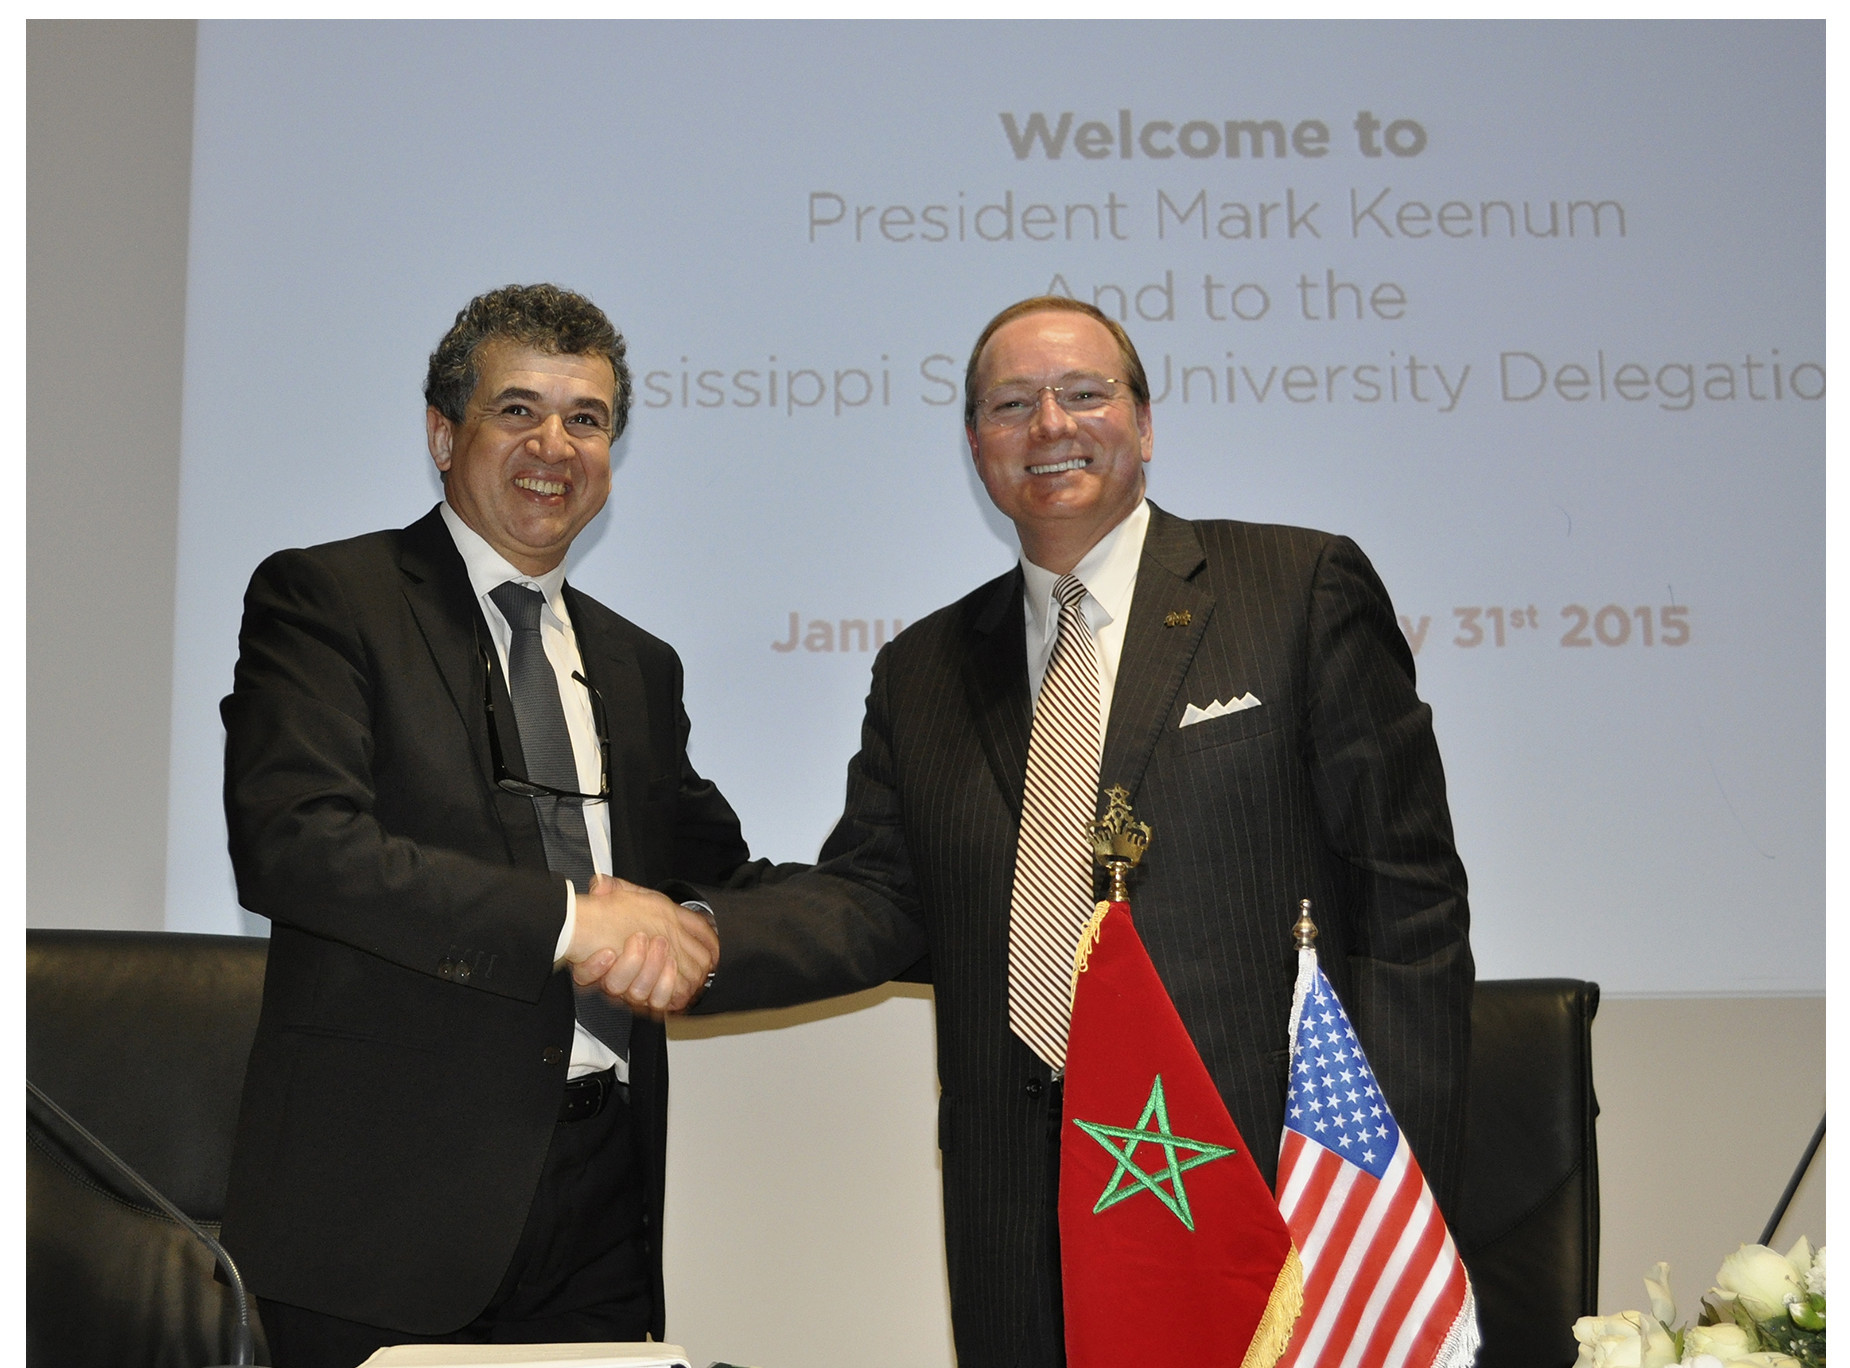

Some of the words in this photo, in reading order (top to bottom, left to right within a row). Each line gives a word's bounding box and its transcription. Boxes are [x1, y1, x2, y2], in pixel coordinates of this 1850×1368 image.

[1000, 109, 1331, 160] Welcome
[1353, 110, 1429, 159] to
[808, 190, 1129, 243] President
[1157, 188, 1321, 240] Mark
[1350, 187, 1628, 239] Keenum
[1202, 274, 1272, 322] to
[1297, 268, 1408, 321] the
[632, 354, 891, 417] sissippi
[1560, 604, 1692, 648] 2015
